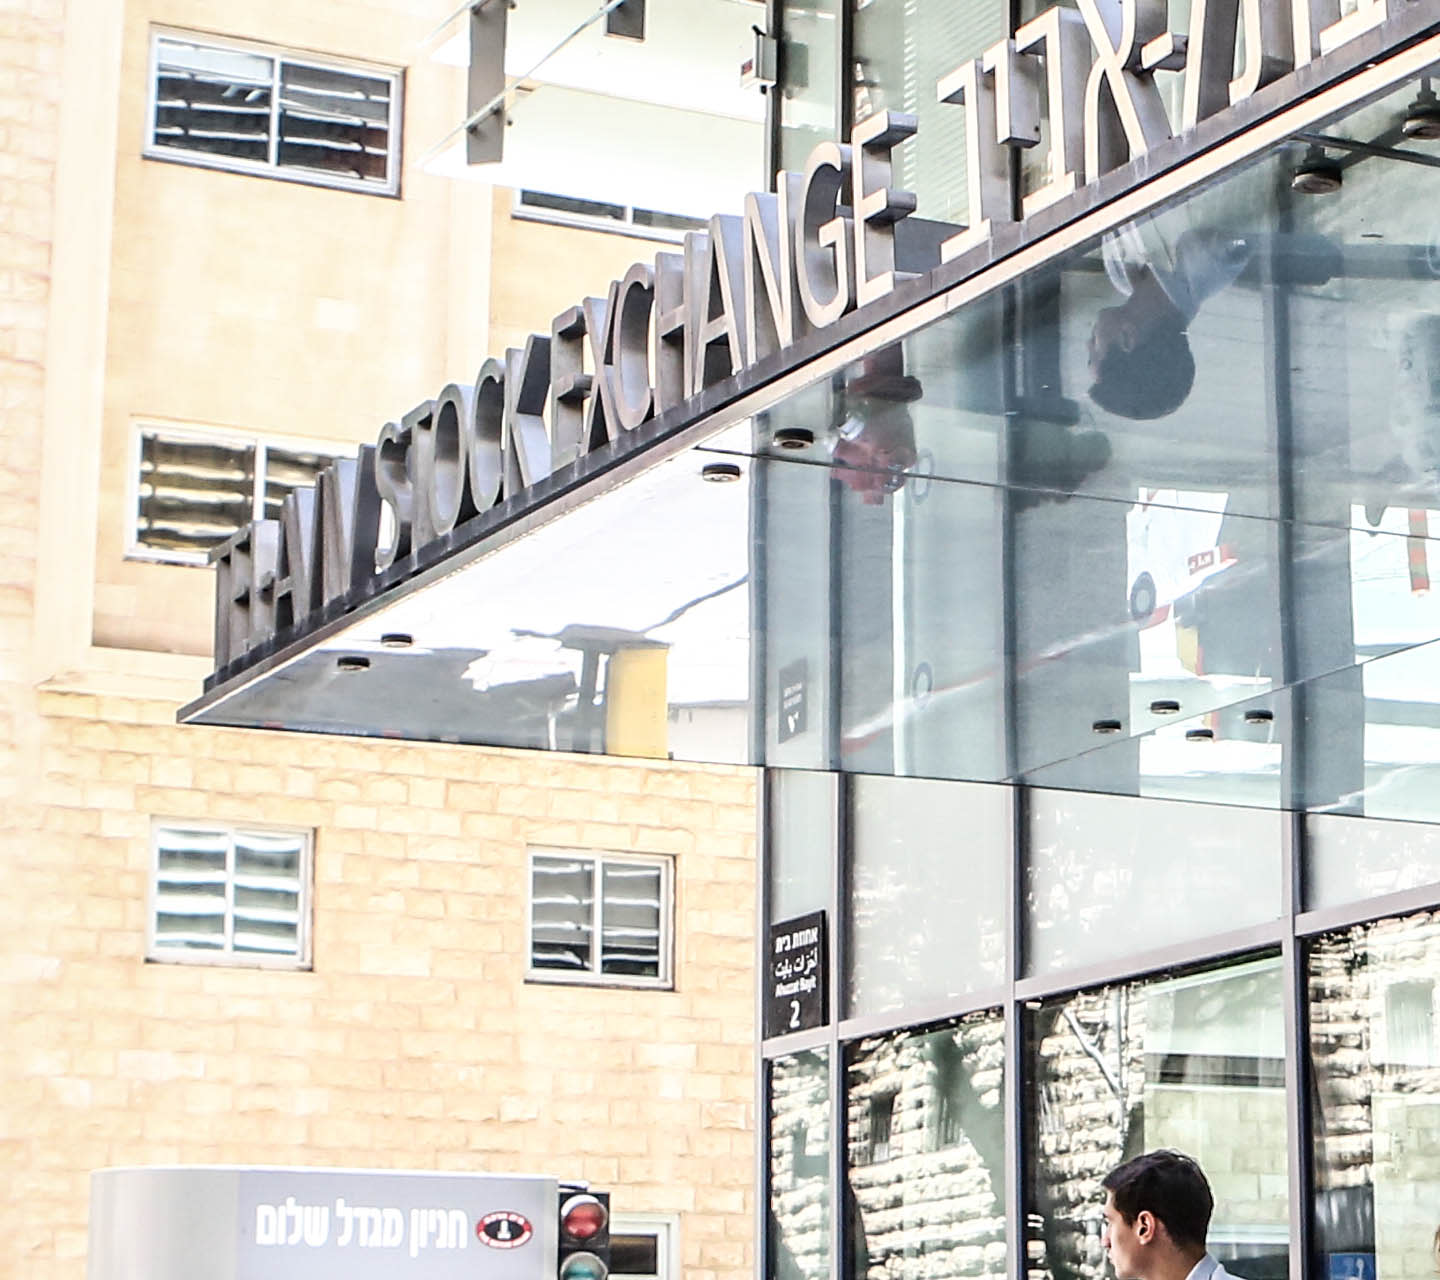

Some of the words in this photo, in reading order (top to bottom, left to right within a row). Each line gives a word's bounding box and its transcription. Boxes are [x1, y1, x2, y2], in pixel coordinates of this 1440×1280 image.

[376, 334, 552, 573] STOCK
[550, 110, 917, 473] EXCHANGE
[775, 934, 791, 954] בית
[789, 1000, 800, 1029] 2
[256, 1196, 329, 1248] שלום
[335, 1197, 404, 1248] מגדל
[409, 1208, 468, 1258] חניון
